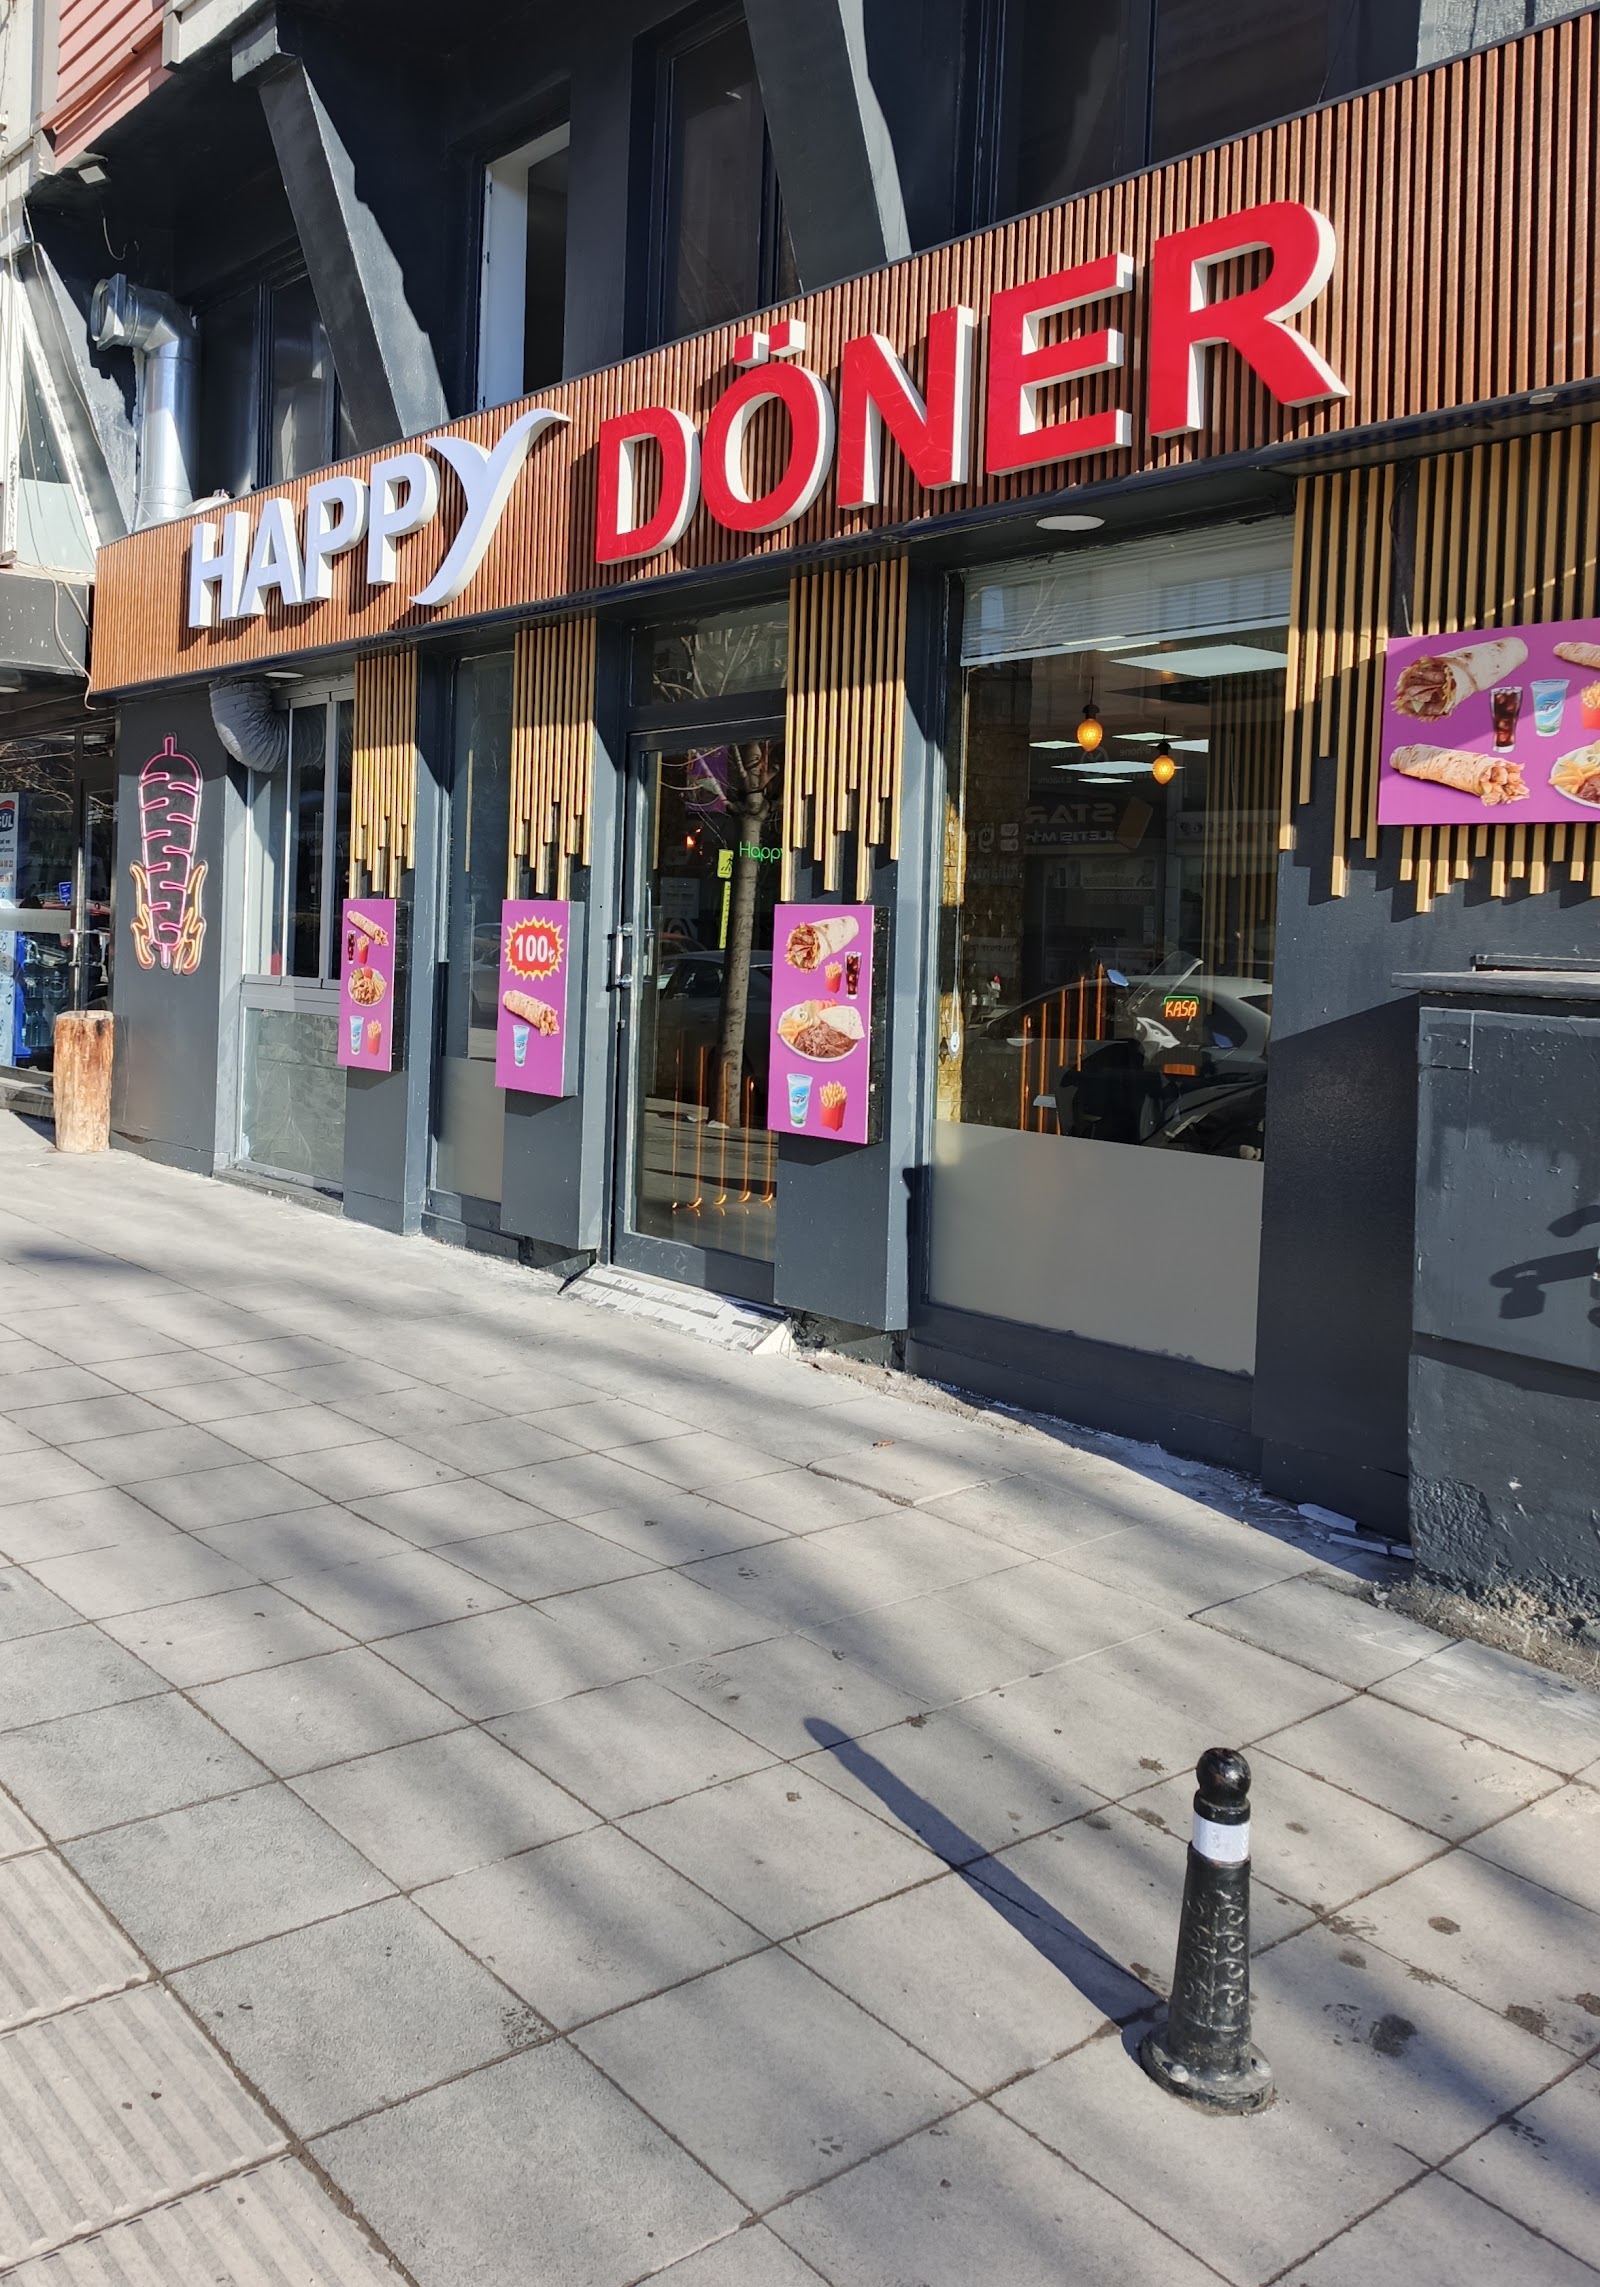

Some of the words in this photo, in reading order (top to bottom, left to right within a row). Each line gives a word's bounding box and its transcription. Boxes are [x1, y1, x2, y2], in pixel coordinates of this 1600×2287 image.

[188, 408, 570, 629] HAPPY
[596, 200, 1350, 565] DÖNER
[739, 840, 783, 864] Happ
[1165, 1000, 1197, 1018] KASA
